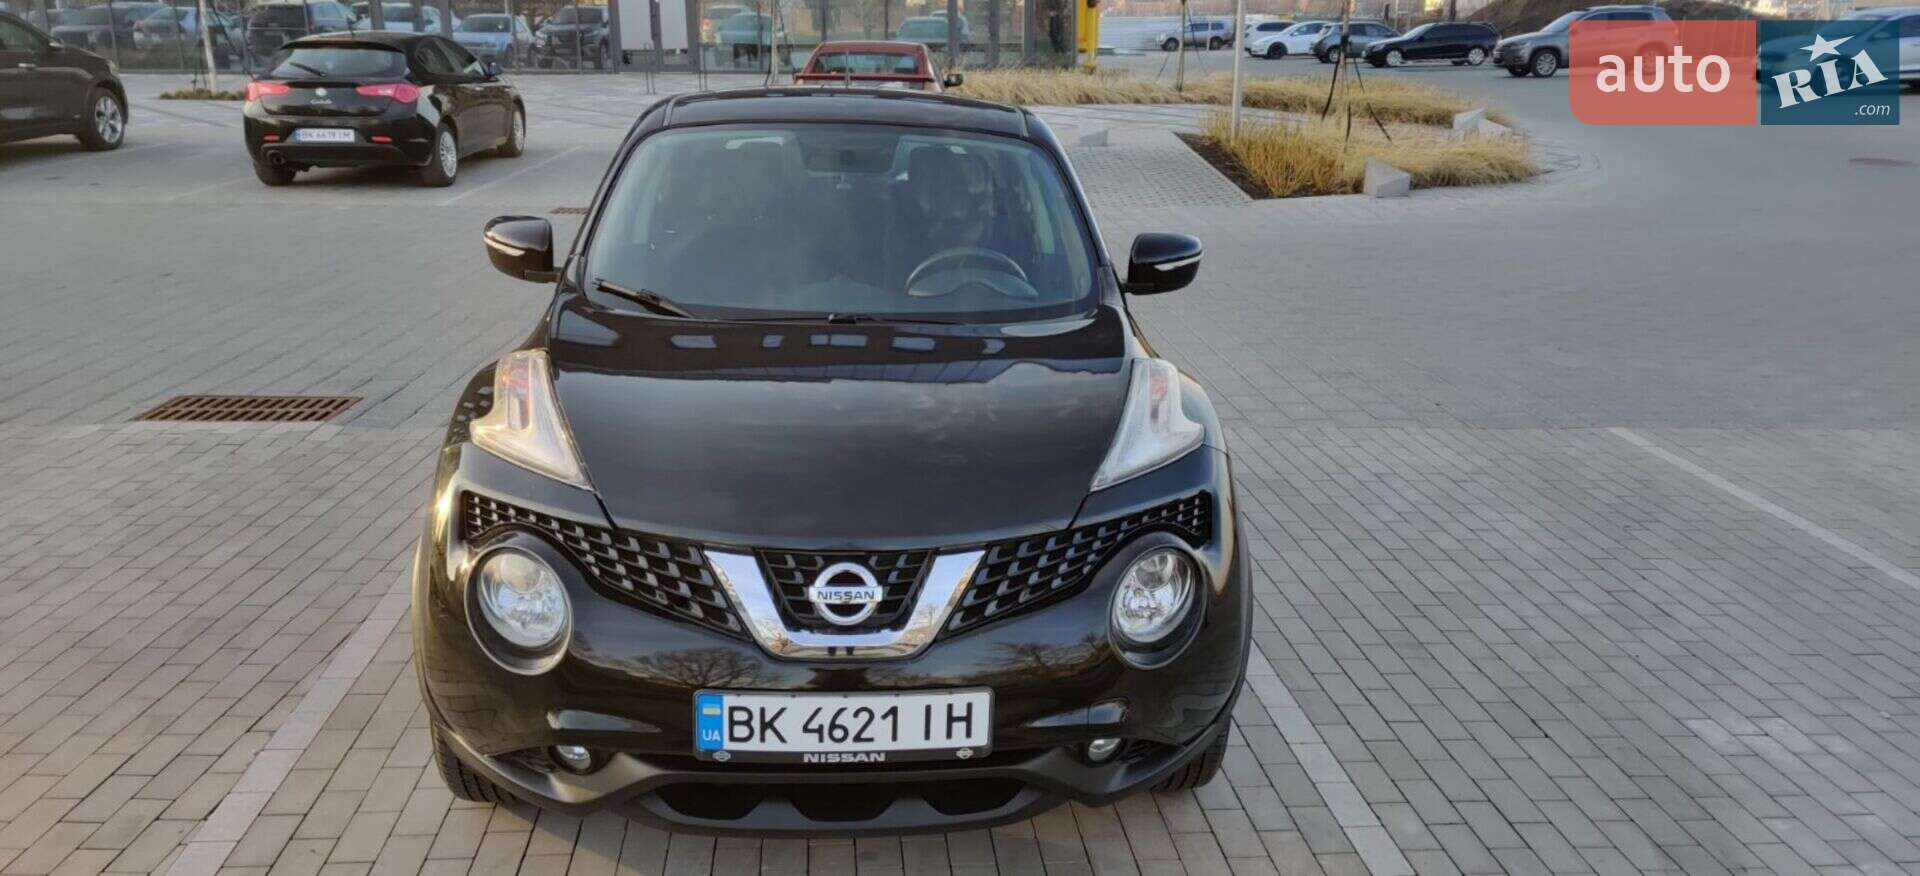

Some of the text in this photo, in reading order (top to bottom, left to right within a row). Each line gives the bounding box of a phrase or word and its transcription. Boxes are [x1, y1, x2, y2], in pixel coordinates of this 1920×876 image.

[817, 590, 875, 601] NISSAN
[728, 702, 973, 744] BK 4621 IH
[702, 729, 721, 741] UA
[803, 752, 886, 763] NISSAN
